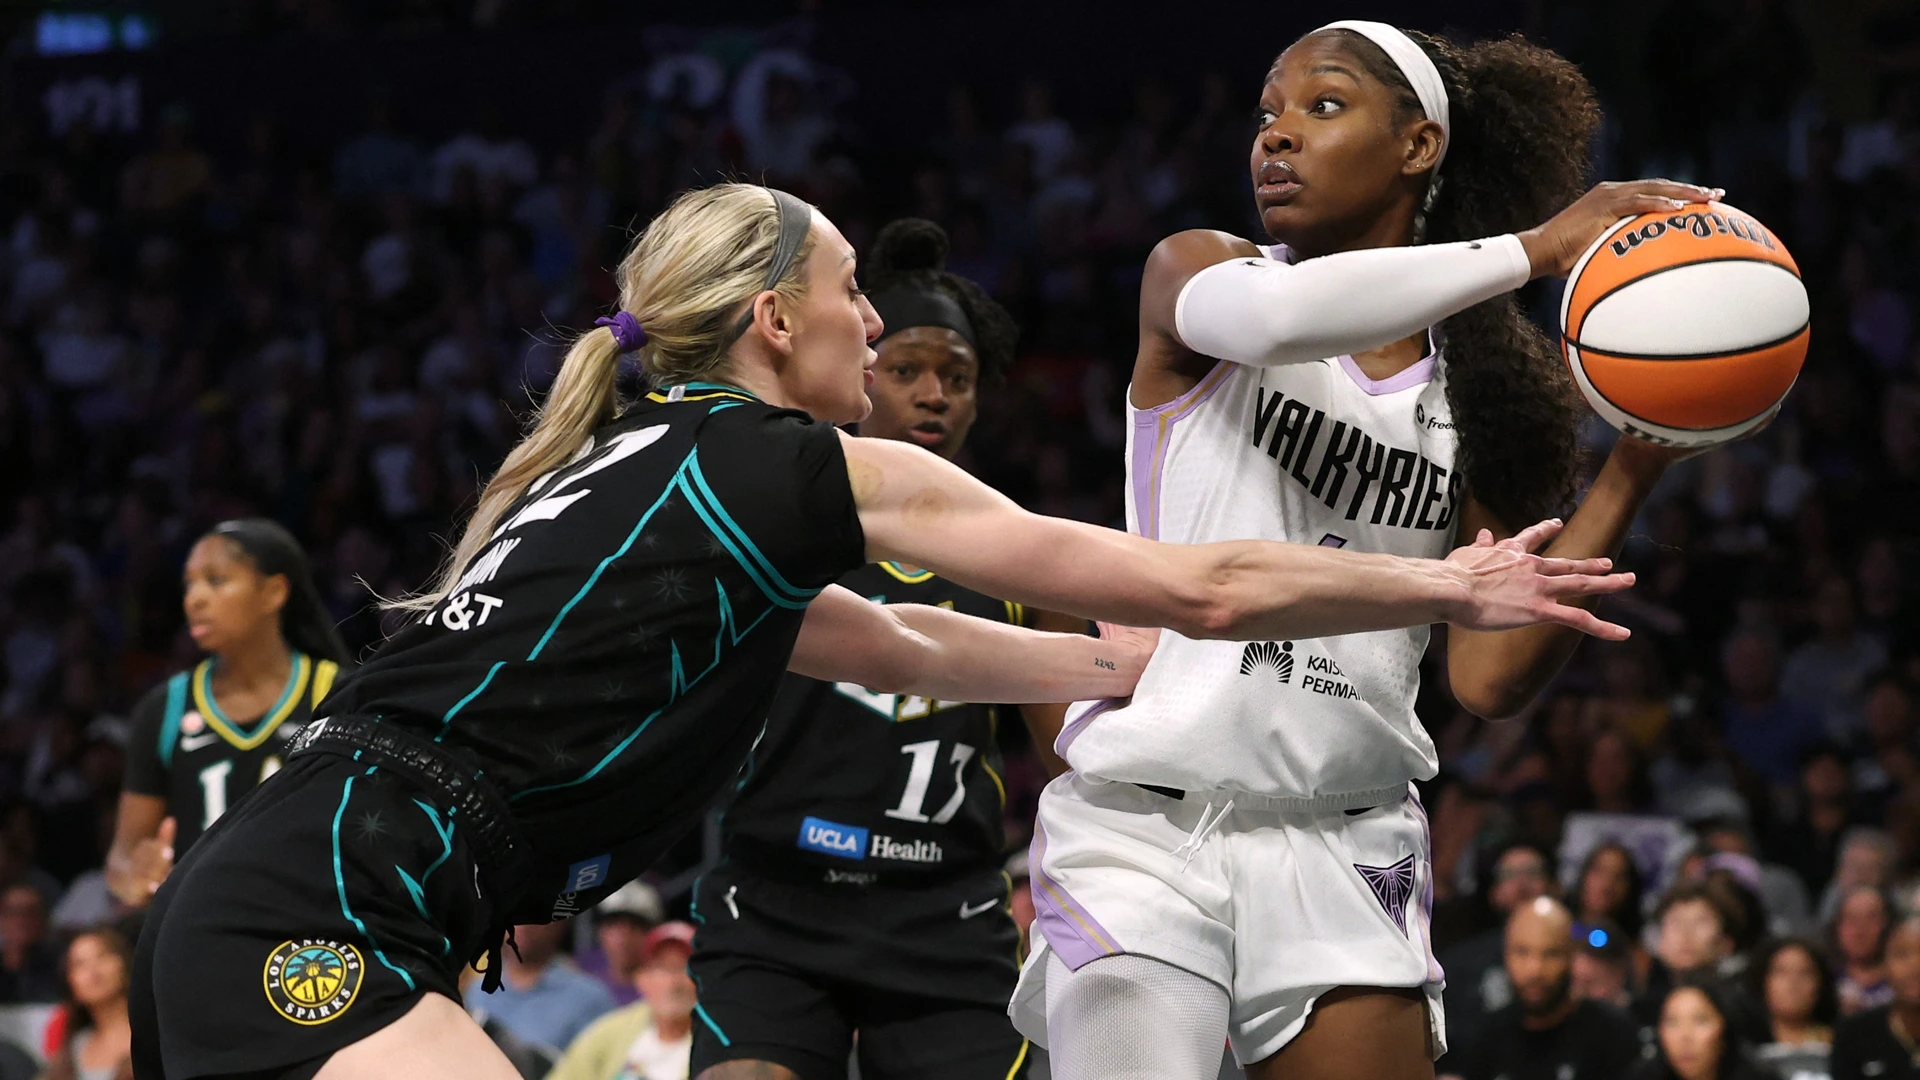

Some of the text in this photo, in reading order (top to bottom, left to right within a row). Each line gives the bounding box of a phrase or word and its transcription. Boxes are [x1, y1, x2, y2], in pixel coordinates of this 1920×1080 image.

[1608, 211, 1776, 257] Wilson
[1253, 386, 1463, 530] VALKYRIES
[884, 739, 976, 825] 17
[807, 825, 943, 863] UCLA Health
[269, 954, 285, 989] LOS
[284, 987, 352, 1020] SPARKS
